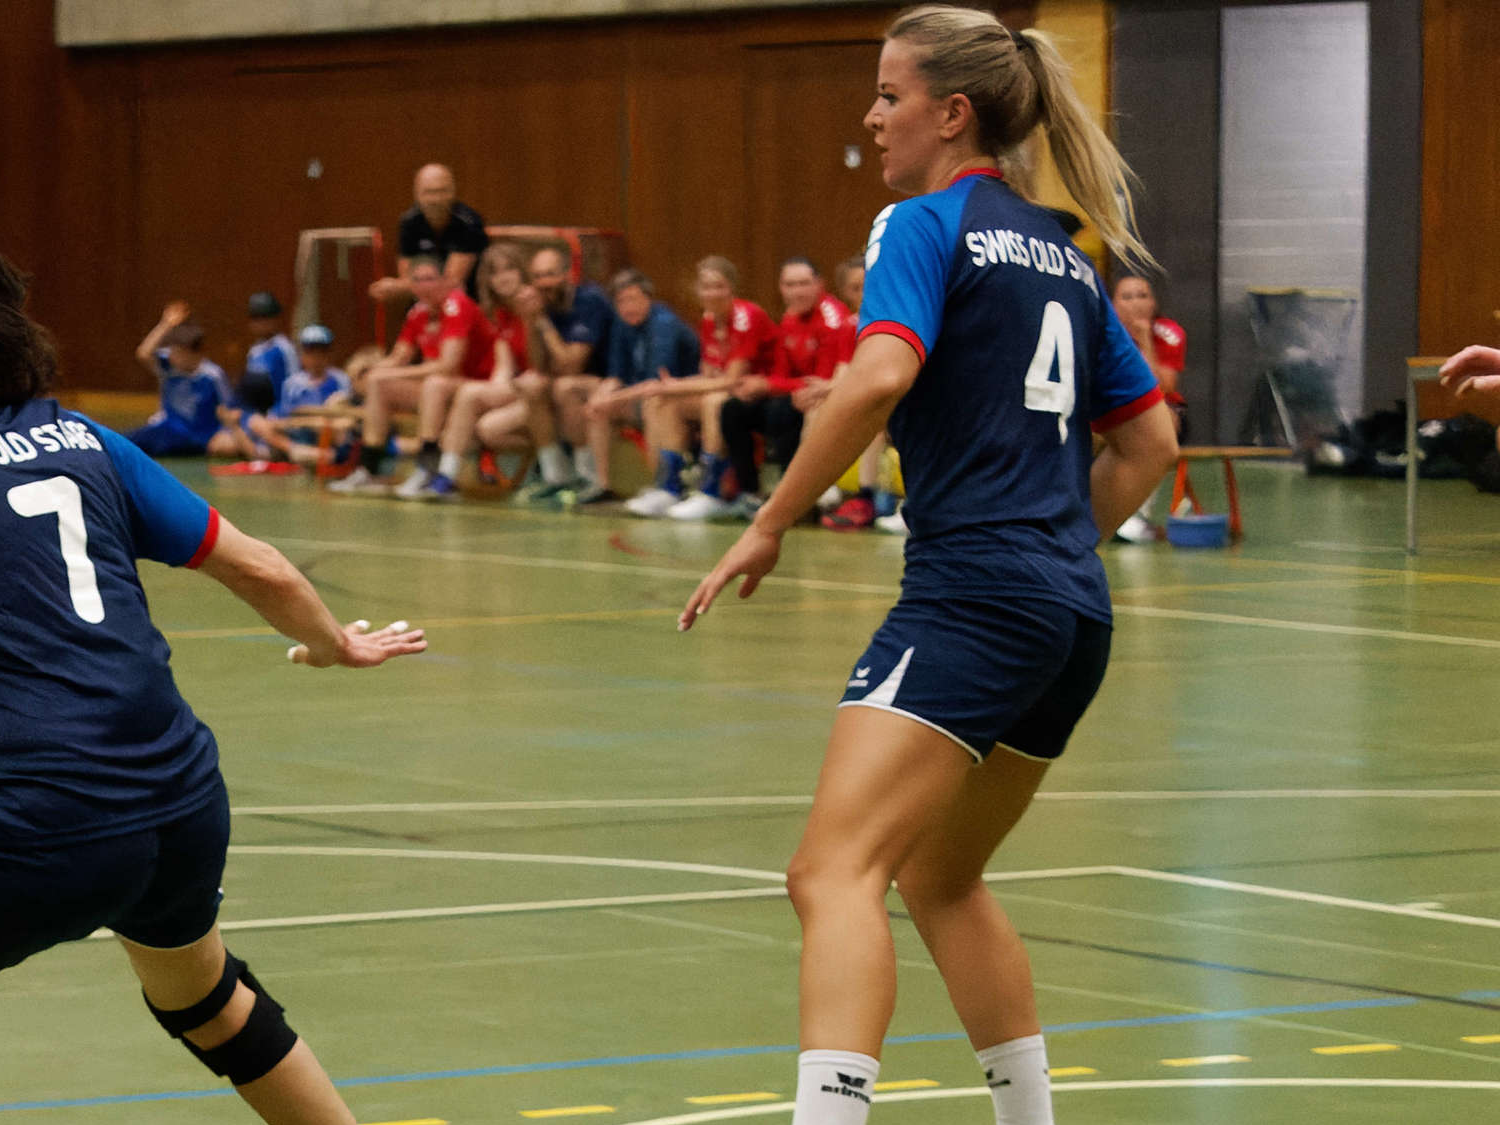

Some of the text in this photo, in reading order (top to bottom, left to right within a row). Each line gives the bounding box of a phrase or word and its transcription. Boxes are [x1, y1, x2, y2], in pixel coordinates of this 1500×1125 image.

[965, 229, 1031, 268] SWISS
[1028, 236, 1066, 277] OLD
[1024, 300, 1077, 445] 4
[7, 475, 106, 625] 7
